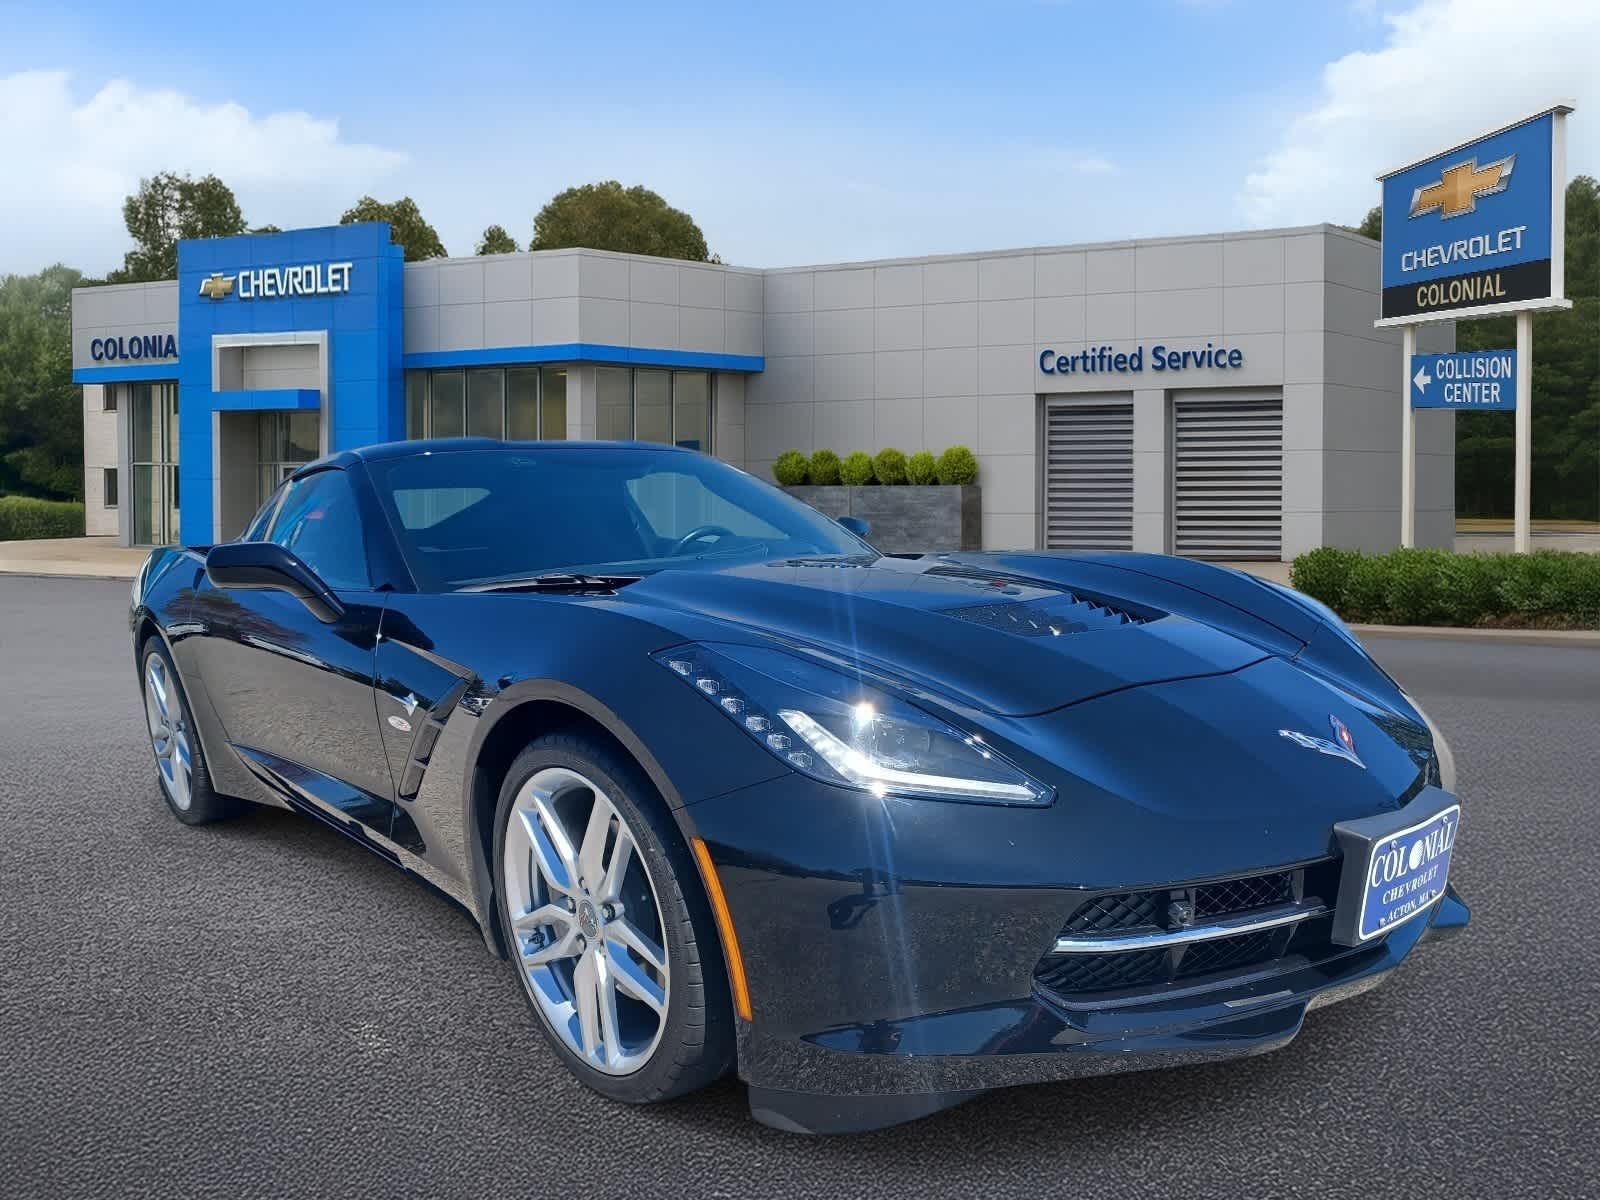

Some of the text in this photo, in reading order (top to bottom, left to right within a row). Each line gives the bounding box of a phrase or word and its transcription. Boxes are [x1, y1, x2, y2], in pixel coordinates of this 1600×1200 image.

[1401, 226, 1526, 272] CHEVROLET
[238, 261, 352, 298] CHEVROLET
[1417, 274, 1506, 306] COLONIAL
[1039, 343, 1243, 374] Certified Service
[1436, 356, 1512, 380] COLLISION
[1444, 382, 1500, 403] CENTER
[1371, 821, 1456, 888] COLONIAL
[1382, 865, 1438, 905] CHEVROLET
